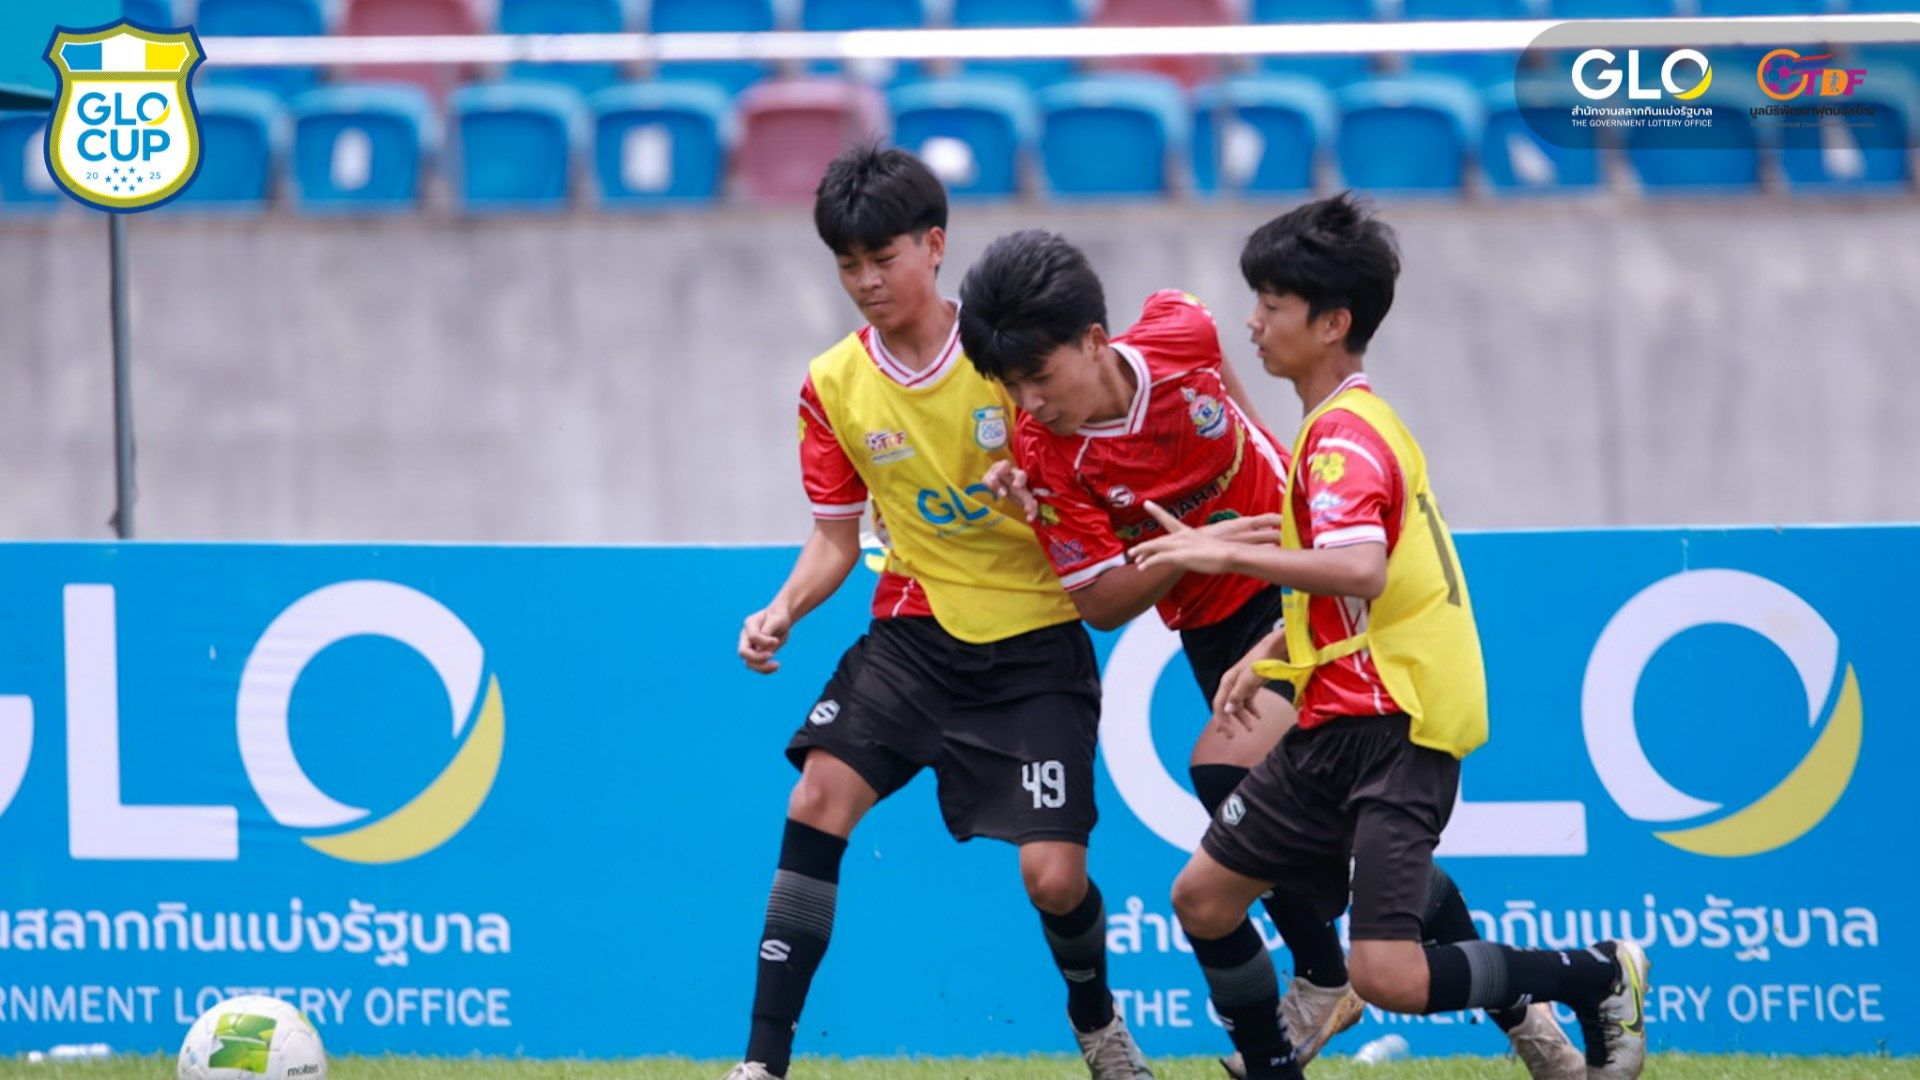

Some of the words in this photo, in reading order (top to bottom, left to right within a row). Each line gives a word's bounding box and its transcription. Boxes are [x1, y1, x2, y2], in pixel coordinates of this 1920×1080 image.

[0, 579, 505, 865] LO
[1021, 760, 1067, 810] 49
[0, 984, 160, 1025] NMENT
[174, 986, 353, 1026] LORY
[363, 986, 512, 1027] OFFICE
[1109, 988, 1194, 1028] THE
[1726, 983, 1885, 1023] OFFICE
